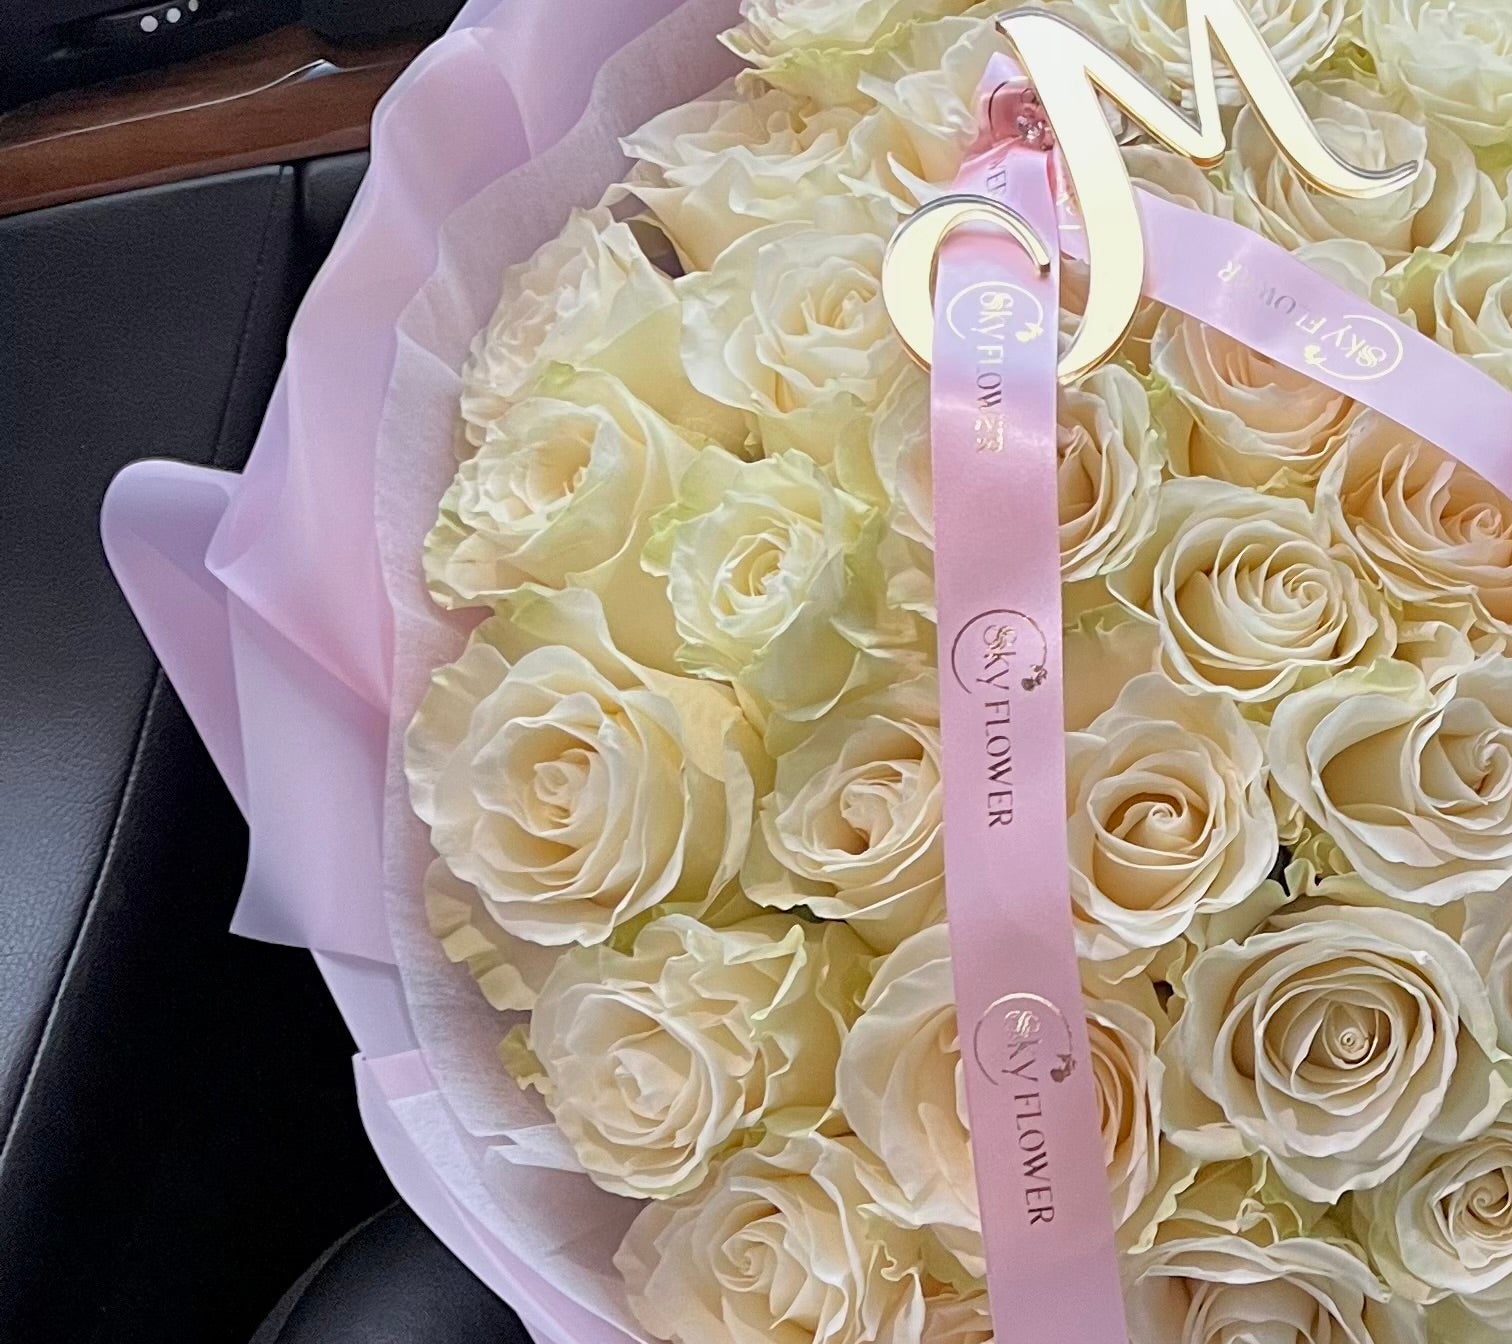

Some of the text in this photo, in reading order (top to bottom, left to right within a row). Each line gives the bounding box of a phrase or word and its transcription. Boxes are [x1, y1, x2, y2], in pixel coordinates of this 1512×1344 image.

[1216, 259, 1328, 336] FLOR
[983, 699, 1015, 828] FLOWER
[1013, 1091, 1056, 1226] FLOWER
